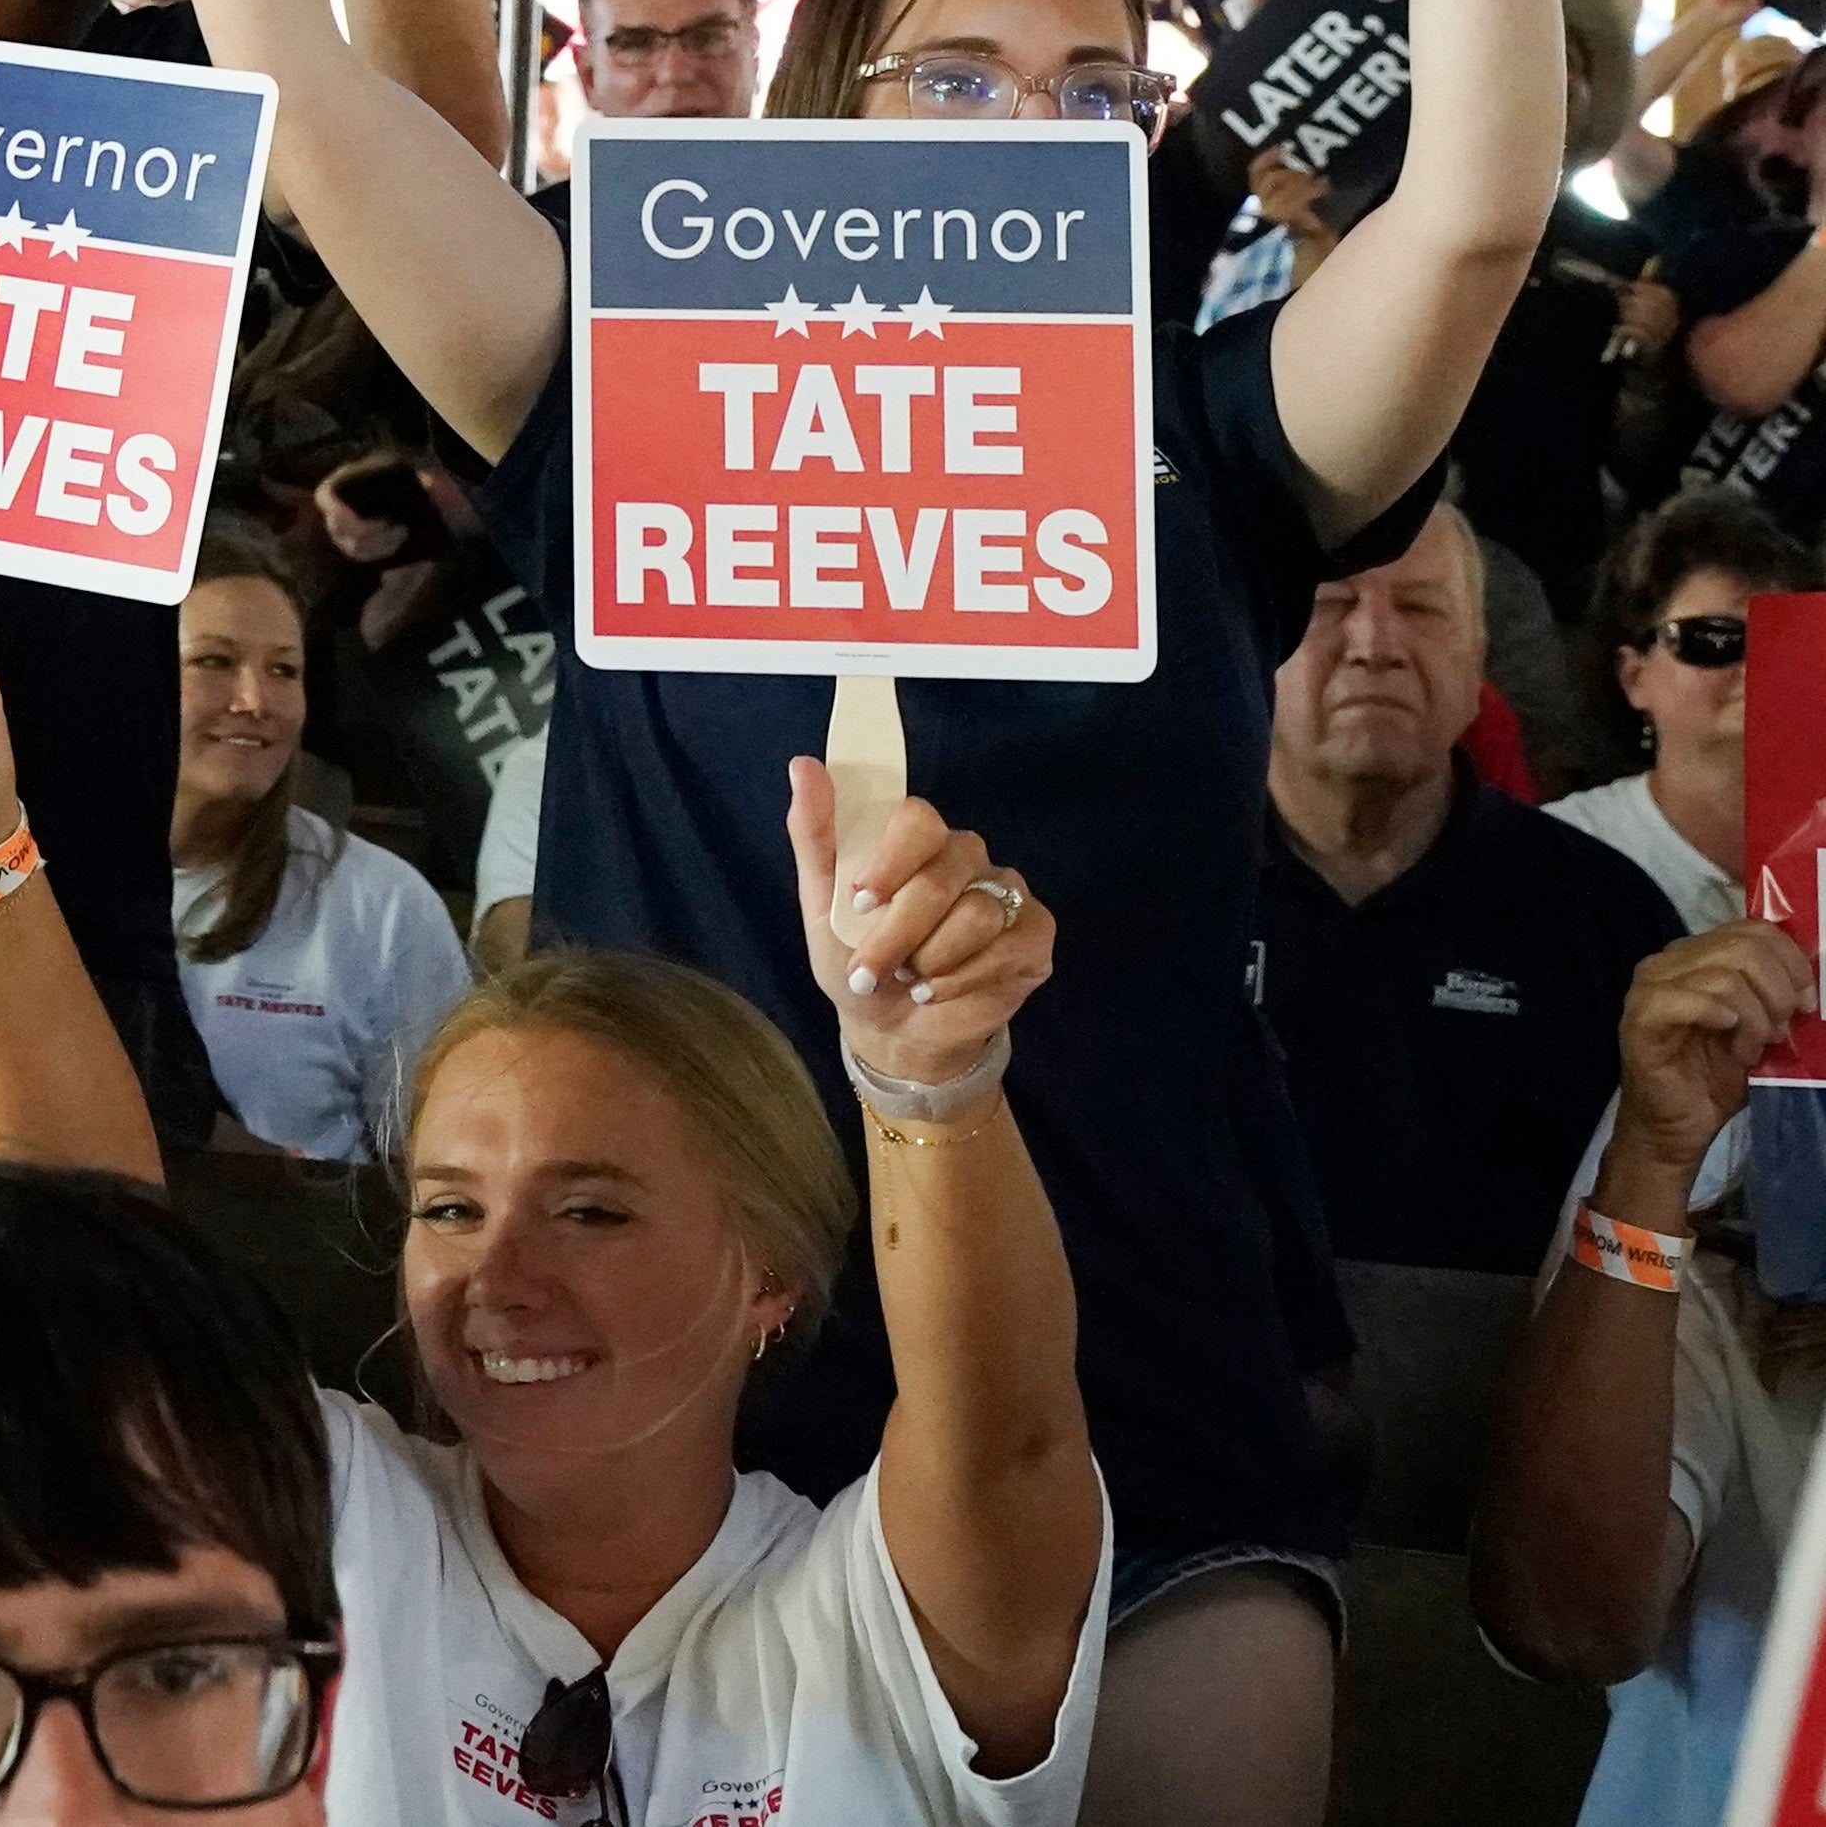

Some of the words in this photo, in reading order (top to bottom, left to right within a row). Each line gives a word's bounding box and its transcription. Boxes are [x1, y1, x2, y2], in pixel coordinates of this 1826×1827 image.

[1220, 10, 1386, 148] LATER,
[640, 177, 1085, 264] Governor
[698, 362, 1025, 475] TATE
[614, 501, 1114, 617] REEVES
[453, 1745, 558, 1821] EEVES
[461, 1719, 521, 1770] TAT
